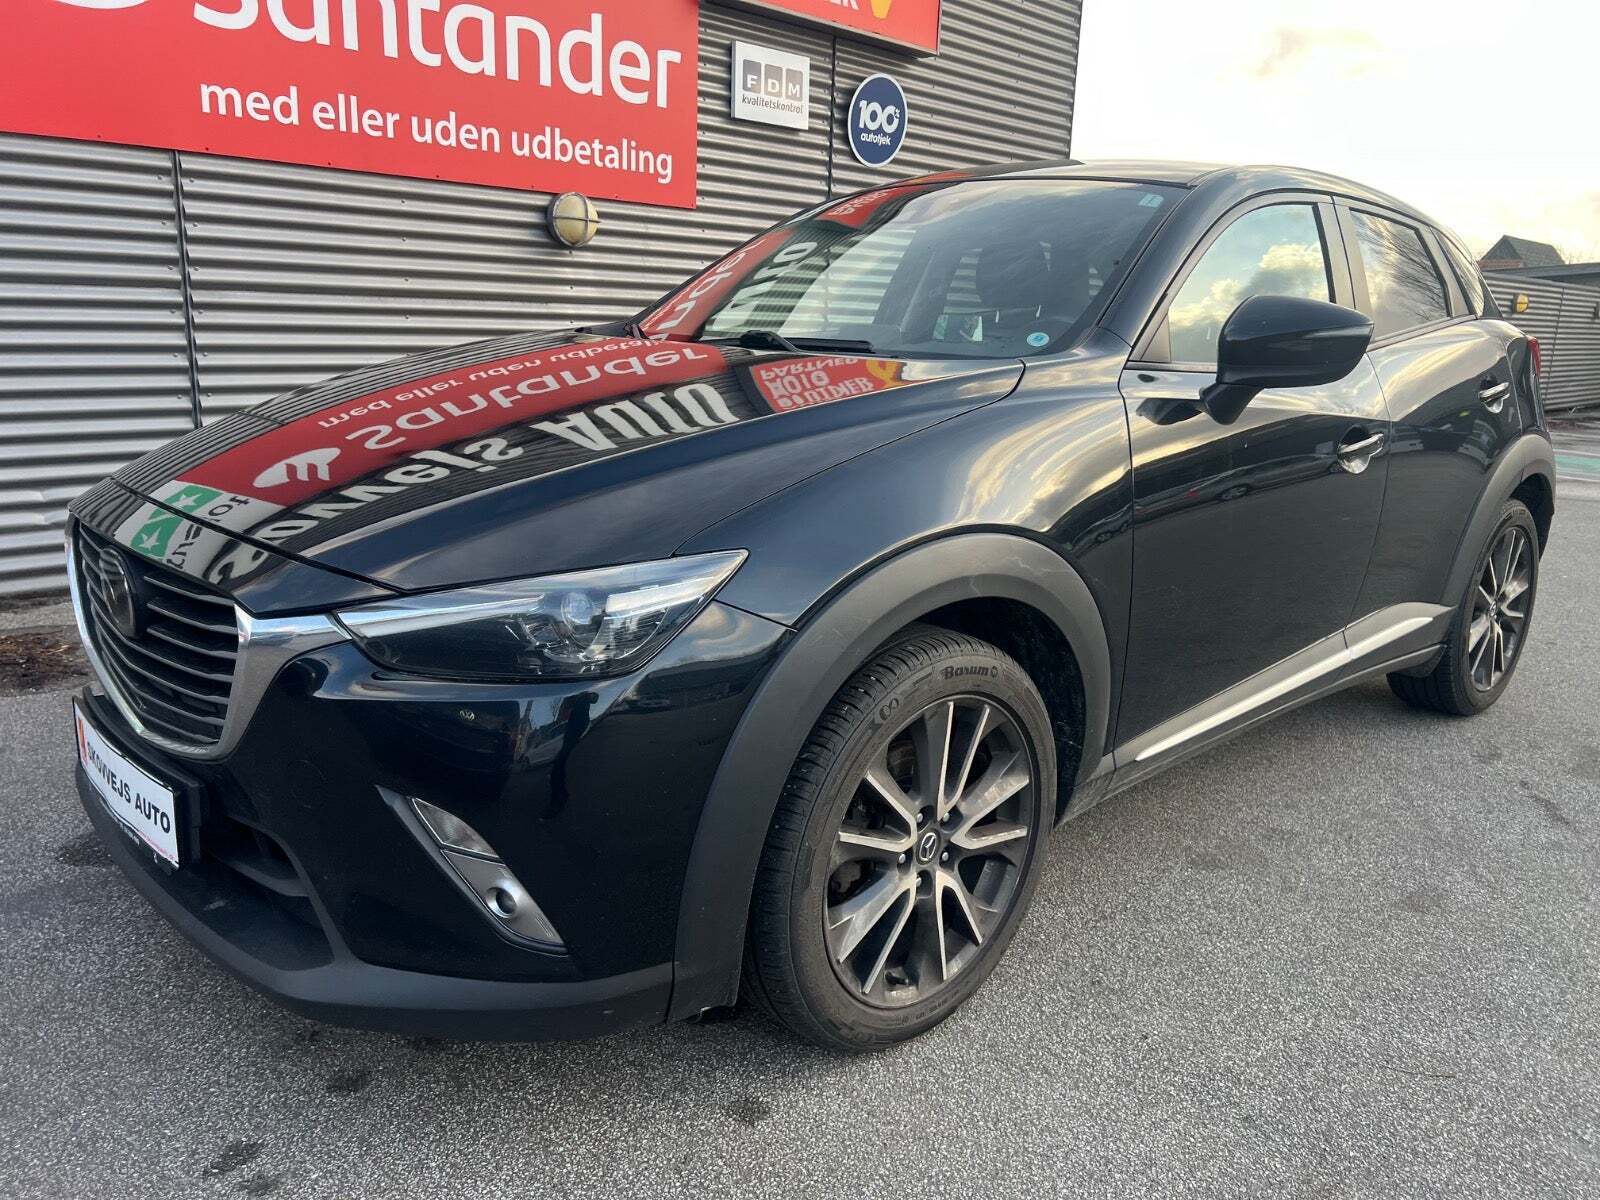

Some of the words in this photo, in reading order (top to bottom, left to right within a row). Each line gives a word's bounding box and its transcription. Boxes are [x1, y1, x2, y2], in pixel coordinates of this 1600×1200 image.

[746, 74, 801, 98] FDM
[742, 94, 804, 115] kvalitetskontrol
[200, 83, 300, 126] med
[312, 93, 400, 139] eller
[410, 110, 501, 153] uden
[511, 126, 673, 185] udbetaling
[860, 132, 892, 146] autotjek
[943, 665, 989, 680] Barum
[134, 793, 171, 834] AUTO
